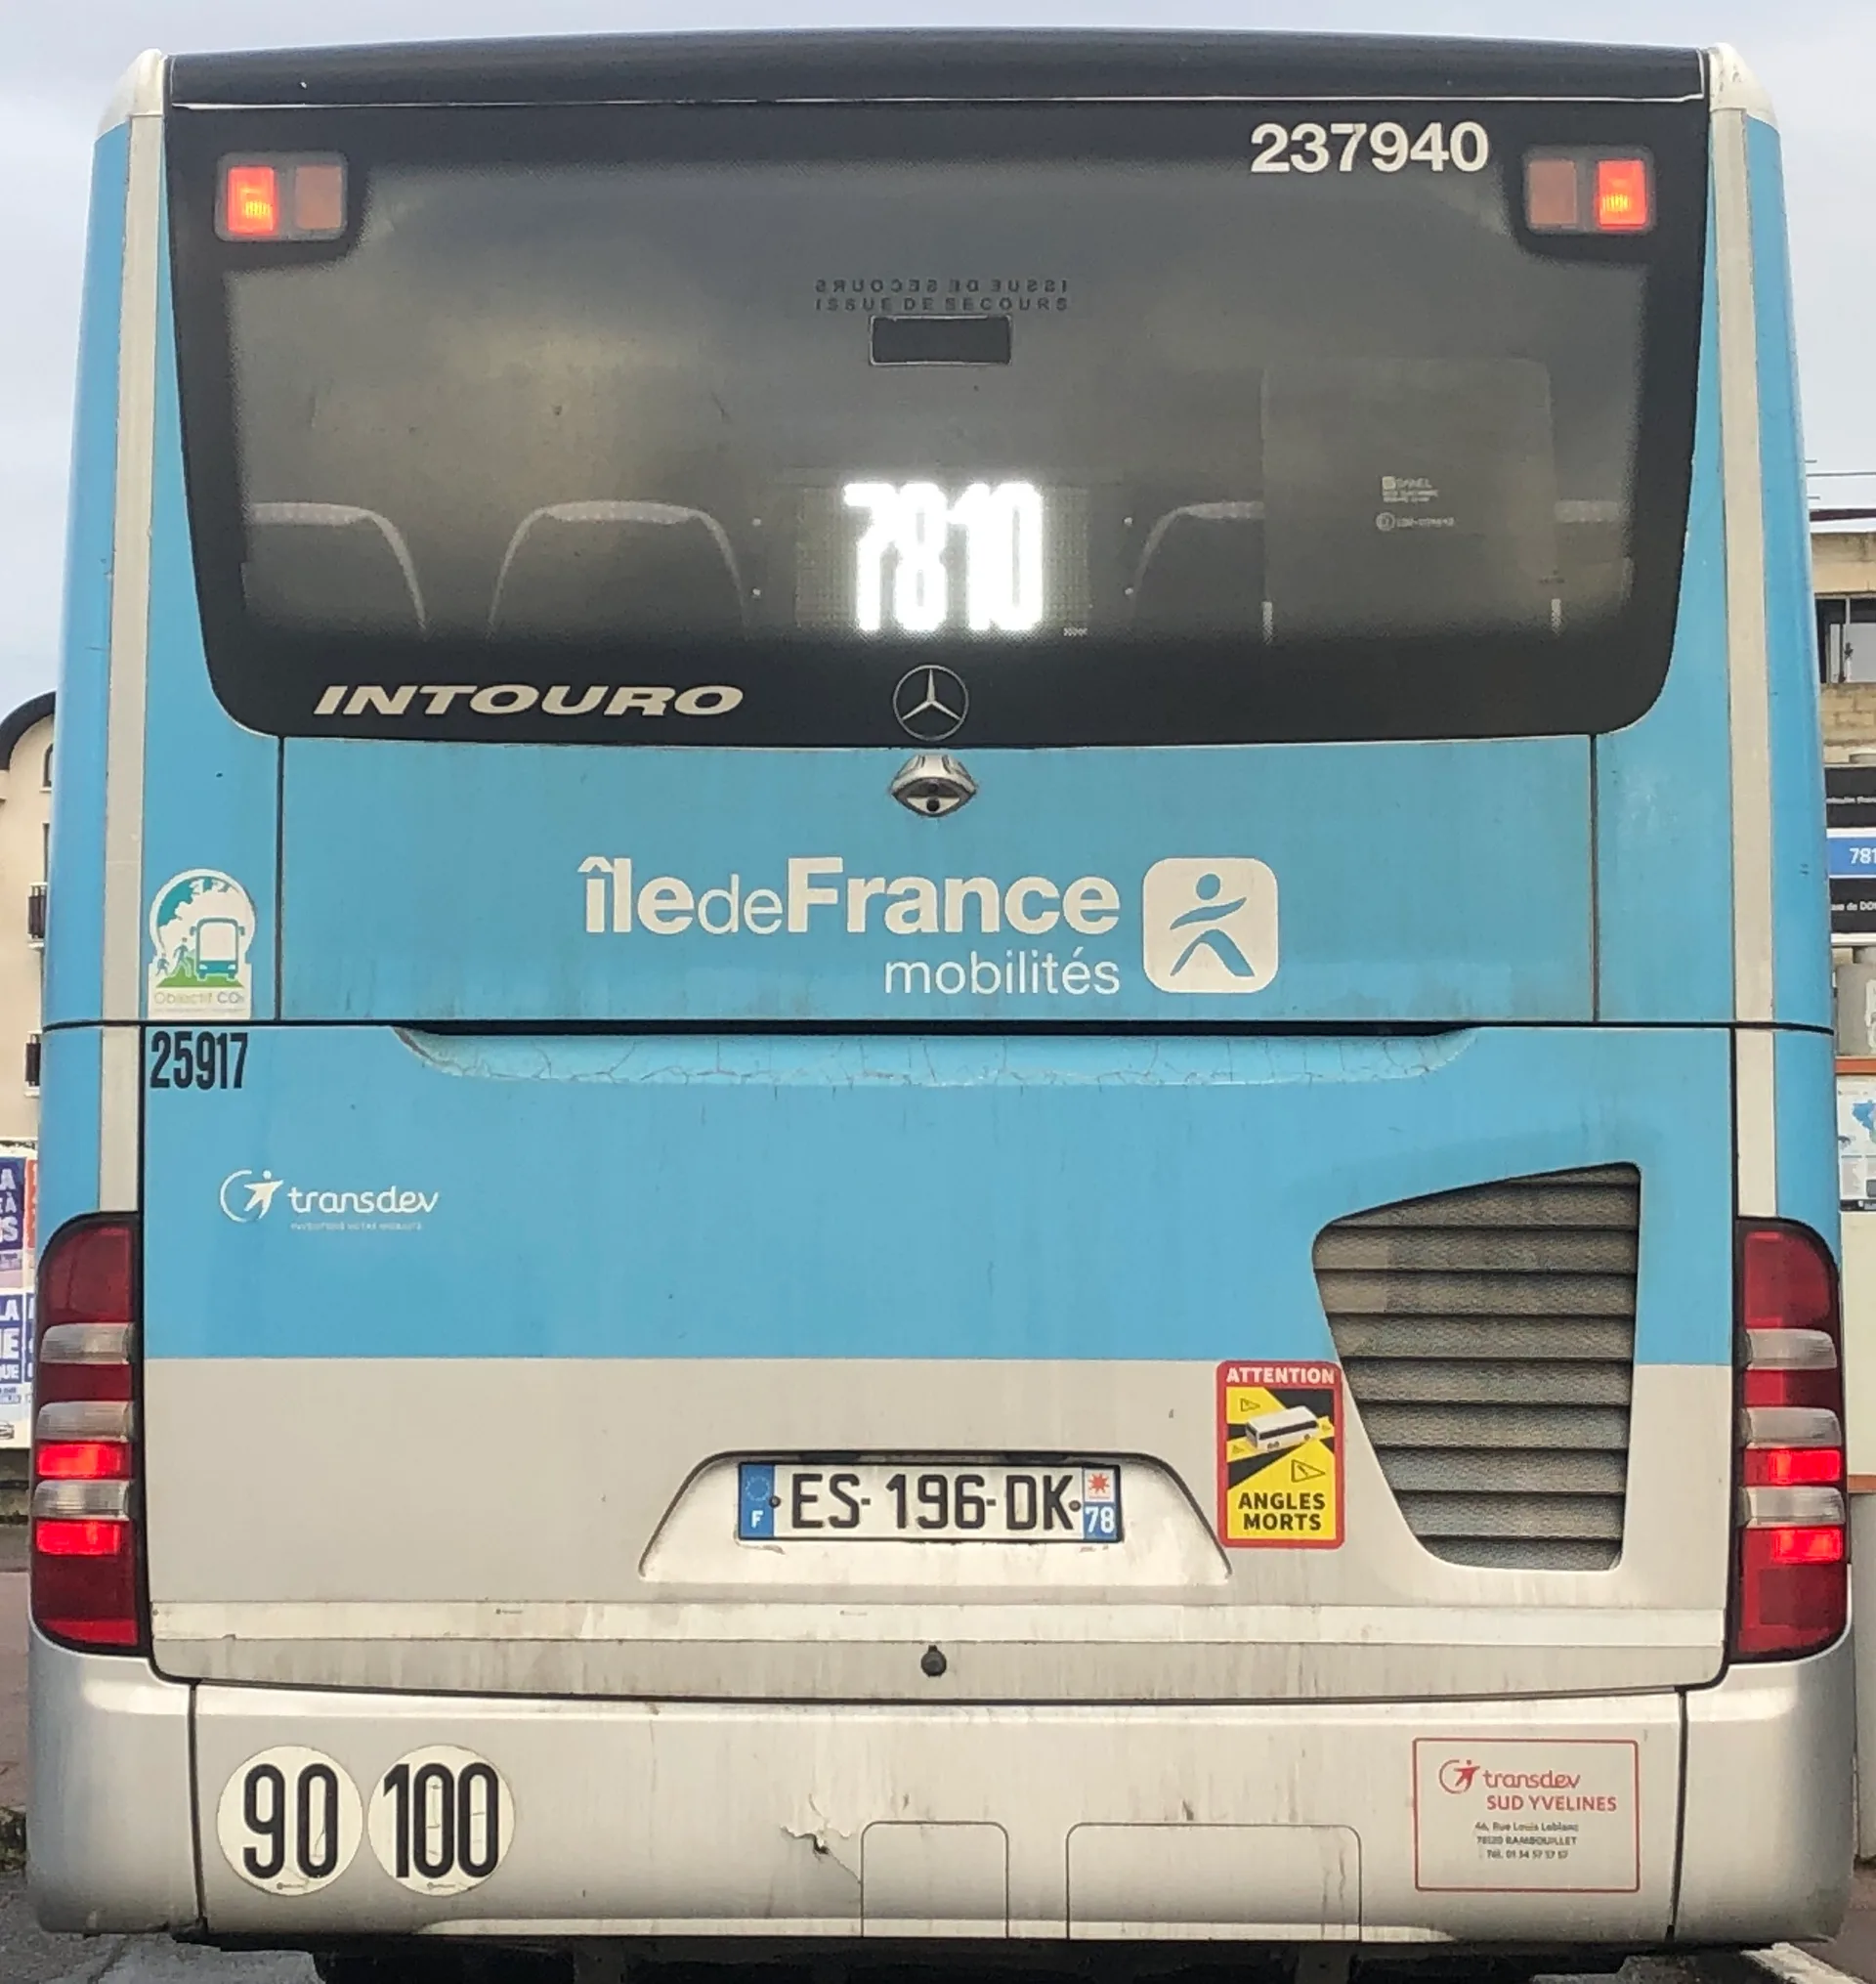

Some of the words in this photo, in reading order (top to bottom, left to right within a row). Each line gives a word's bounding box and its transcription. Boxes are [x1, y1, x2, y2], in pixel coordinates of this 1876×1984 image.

[1251, 121, 1488, 172] 237940
[815, 297, 892, 311] ISSUE
[904, 297, 934, 311] DE
[945, 297, 1068, 311] SECOURS
[843, 482, 1043, 632] 7810
[313, 685, 744, 715] INTOURO
[884, 946, 1121, 995] mobilités
[149, 1030, 248, 1090] 25917
[287, 1186, 439, 1213] transdev
[1226, 1367, 1335, 1384] ATTENTION
[1238, 1492, 1326, 1510] ANGLES
[751, 1510, 764, 1529] F
[1085, 1505, 1115, 1533] 78
[1243, 1514, 1322, 1531] MORTS
[1482, 1770, 1581, 1789] transdev
[1487, 1795, 1524, 1810] SUD
[1529, 1796, 1617, 1811] YVELINES
[243, 1763, 339, 1879] 90
[383, 1762, 499, 1878] 100
[1493, 1822, 1512, 1831] Rue
[1506, 1836, 1577, 1845] RAMBOUILLET
